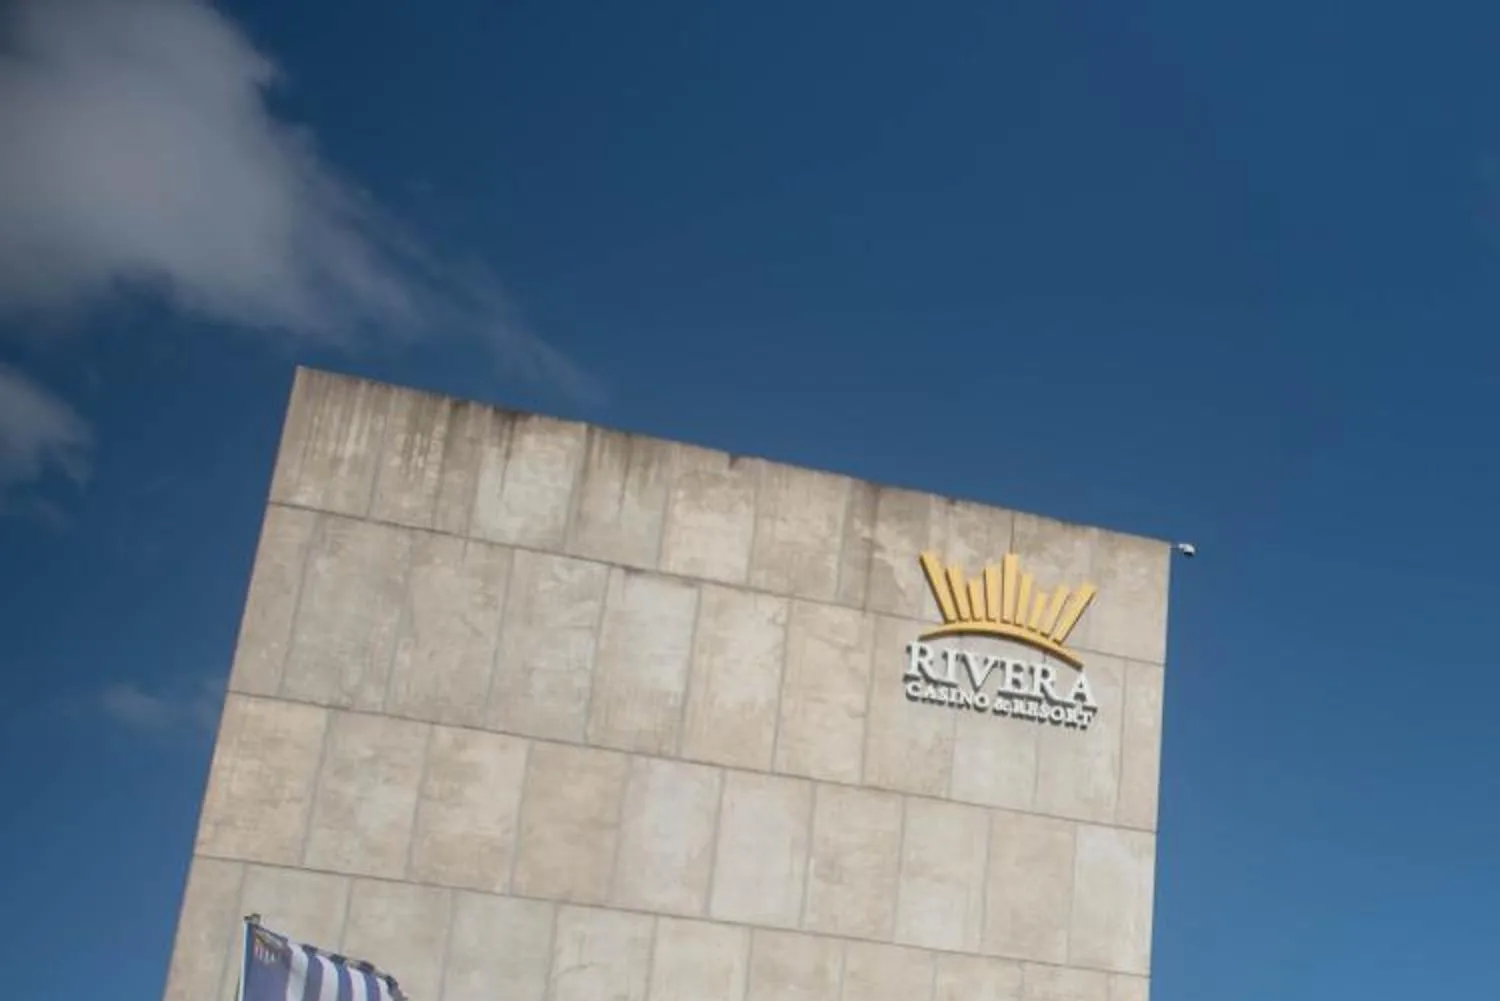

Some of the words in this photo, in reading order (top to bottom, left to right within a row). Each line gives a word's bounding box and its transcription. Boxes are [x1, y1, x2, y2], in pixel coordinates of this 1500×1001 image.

[904, 641, 1097, 710] RIVERA
[905, 681, 990, 711] CASINO
[993, 698, 1012, 716] &
[1011, 699, 1094, 729] RESORT
